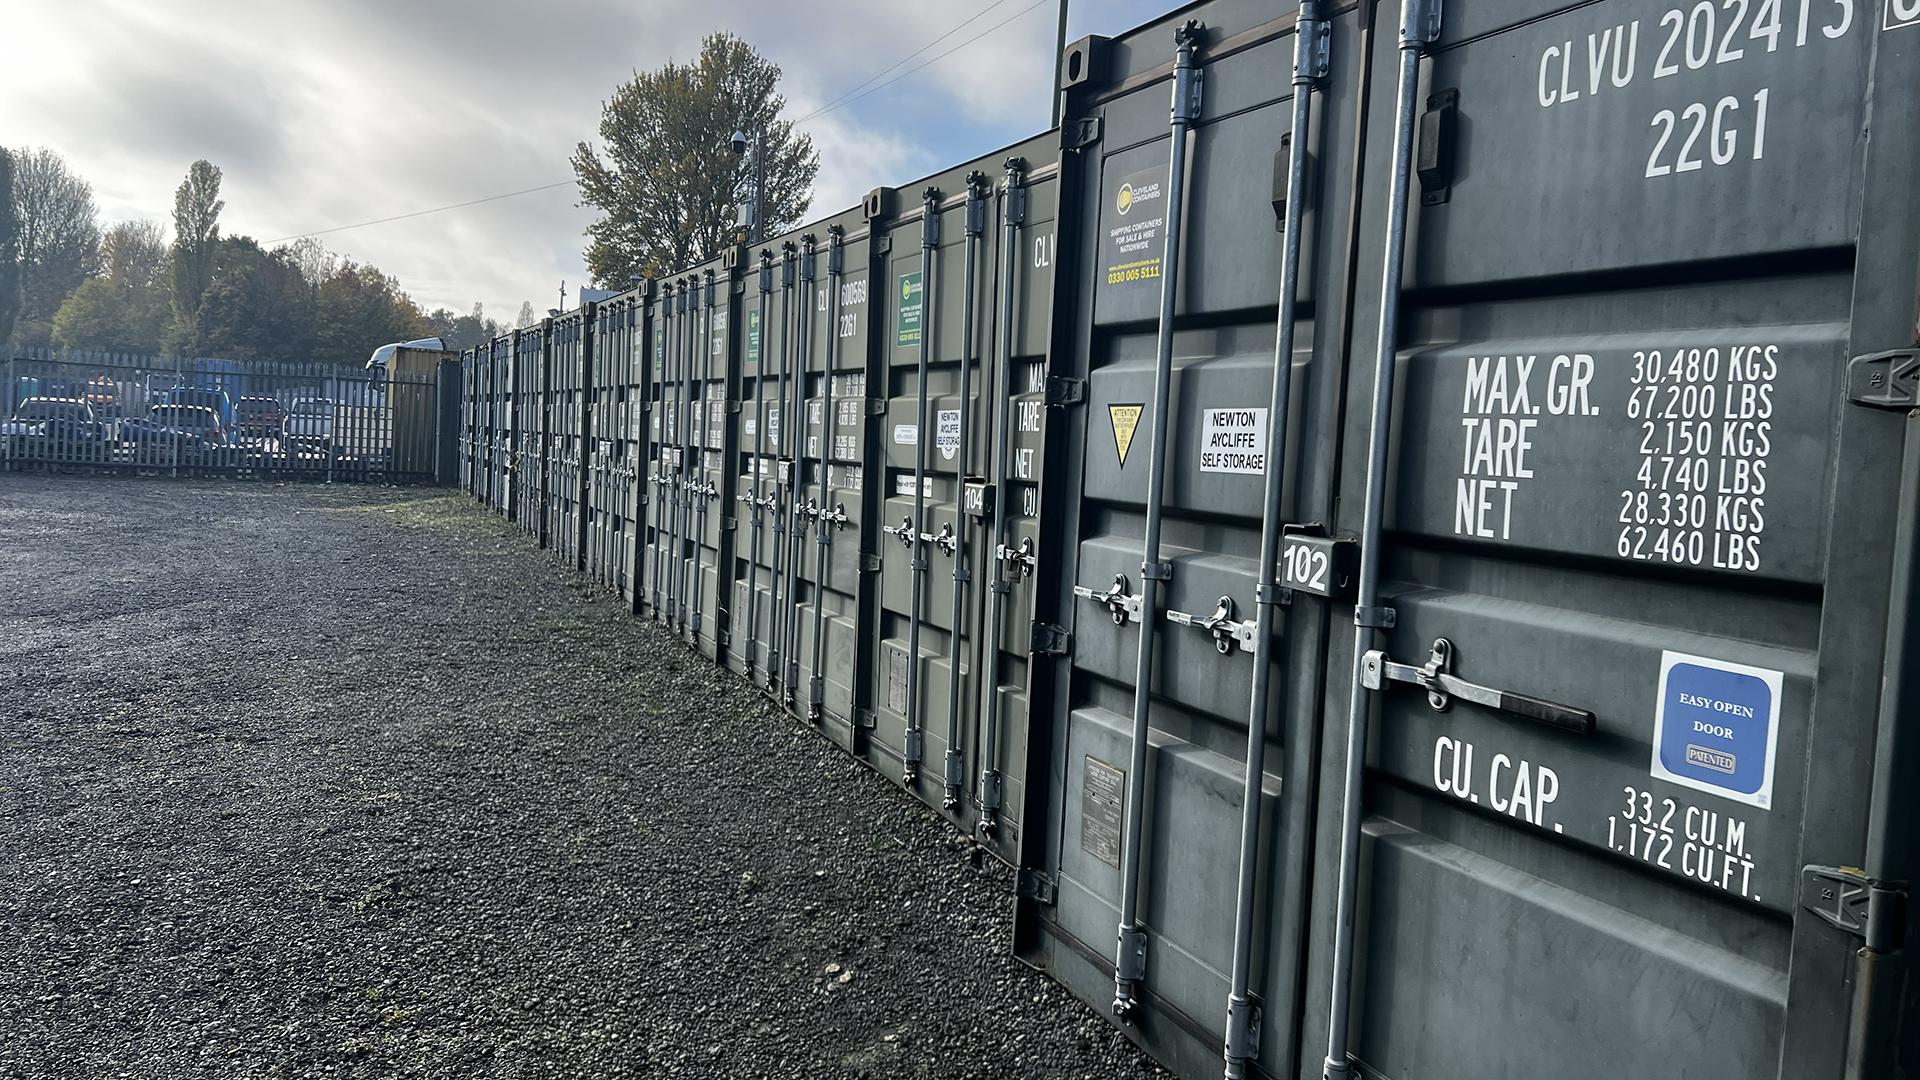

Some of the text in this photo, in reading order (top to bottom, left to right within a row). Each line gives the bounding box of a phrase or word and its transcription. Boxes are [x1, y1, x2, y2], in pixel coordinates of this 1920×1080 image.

[1645, 88, 1770, 178] 22G1
[1132, 190, 1161, 204] CONTAINERS
[1133, 183, 1159, 196] CLEVELAND
[1110, 218, 1162, 237] SHIPPING CONTAINERS
[1115, 229, 1155, 245] FOR SALE & HIRE
[1120, 240, 1149, 253] NATIONWIDE
[1108, 265, 1159, 284] 0330 005 5111
[840, 313, 857, 337] 22G1
[1630, 345, 1778, 386] 30,480 KGS
[1462, 354, 1600, 416] MAX. GR.
[809, 403, 821, 424] TARE
[1627, 383, 1773, 420] 67,200 LBS
[941, 412, 959, 421] NEWTON
[941, 424, 959, 433] AYCLIFFE
[1018, 401, 1040, 432] TARE
[1212, 411, 1256, 427] NEWTON
[807, 436, 818, 457] NET
[937, 436, 945, 445] SELF
[1210, 432, 1255, 448] AYCLIFFE
[1462, 418, 1538, 479] TARE
[1640, 421, 1771, 457] 2,150 KGS
[1014, 448, 1034, 479] NET
[1201, 452, 1263, 470] SELF STORAGE
[1637, 456, 1767, 496] 4,740 LBS
[965, 488, 982, 510] 104
[1454, 478, 1518, 540] NET
[1619, 490, 1765, 534] 28,330 KGS
[1617, 525, 1761, 571] 62,460 LBS
[1283, 544, 1328, 592] 102
[1679, 692, 1754, 718] EASY OPEN
[1693, 720, 1734, 740] DOOR
[1689, 749, 1733, 769] PATENTED
[1433, 736, 1563, 834] CU. CAP.
[1622, 786, 1752, 859] 33.2 CU.M.
[1607, 815, 1762, 902] 1,172 CU.FT.
